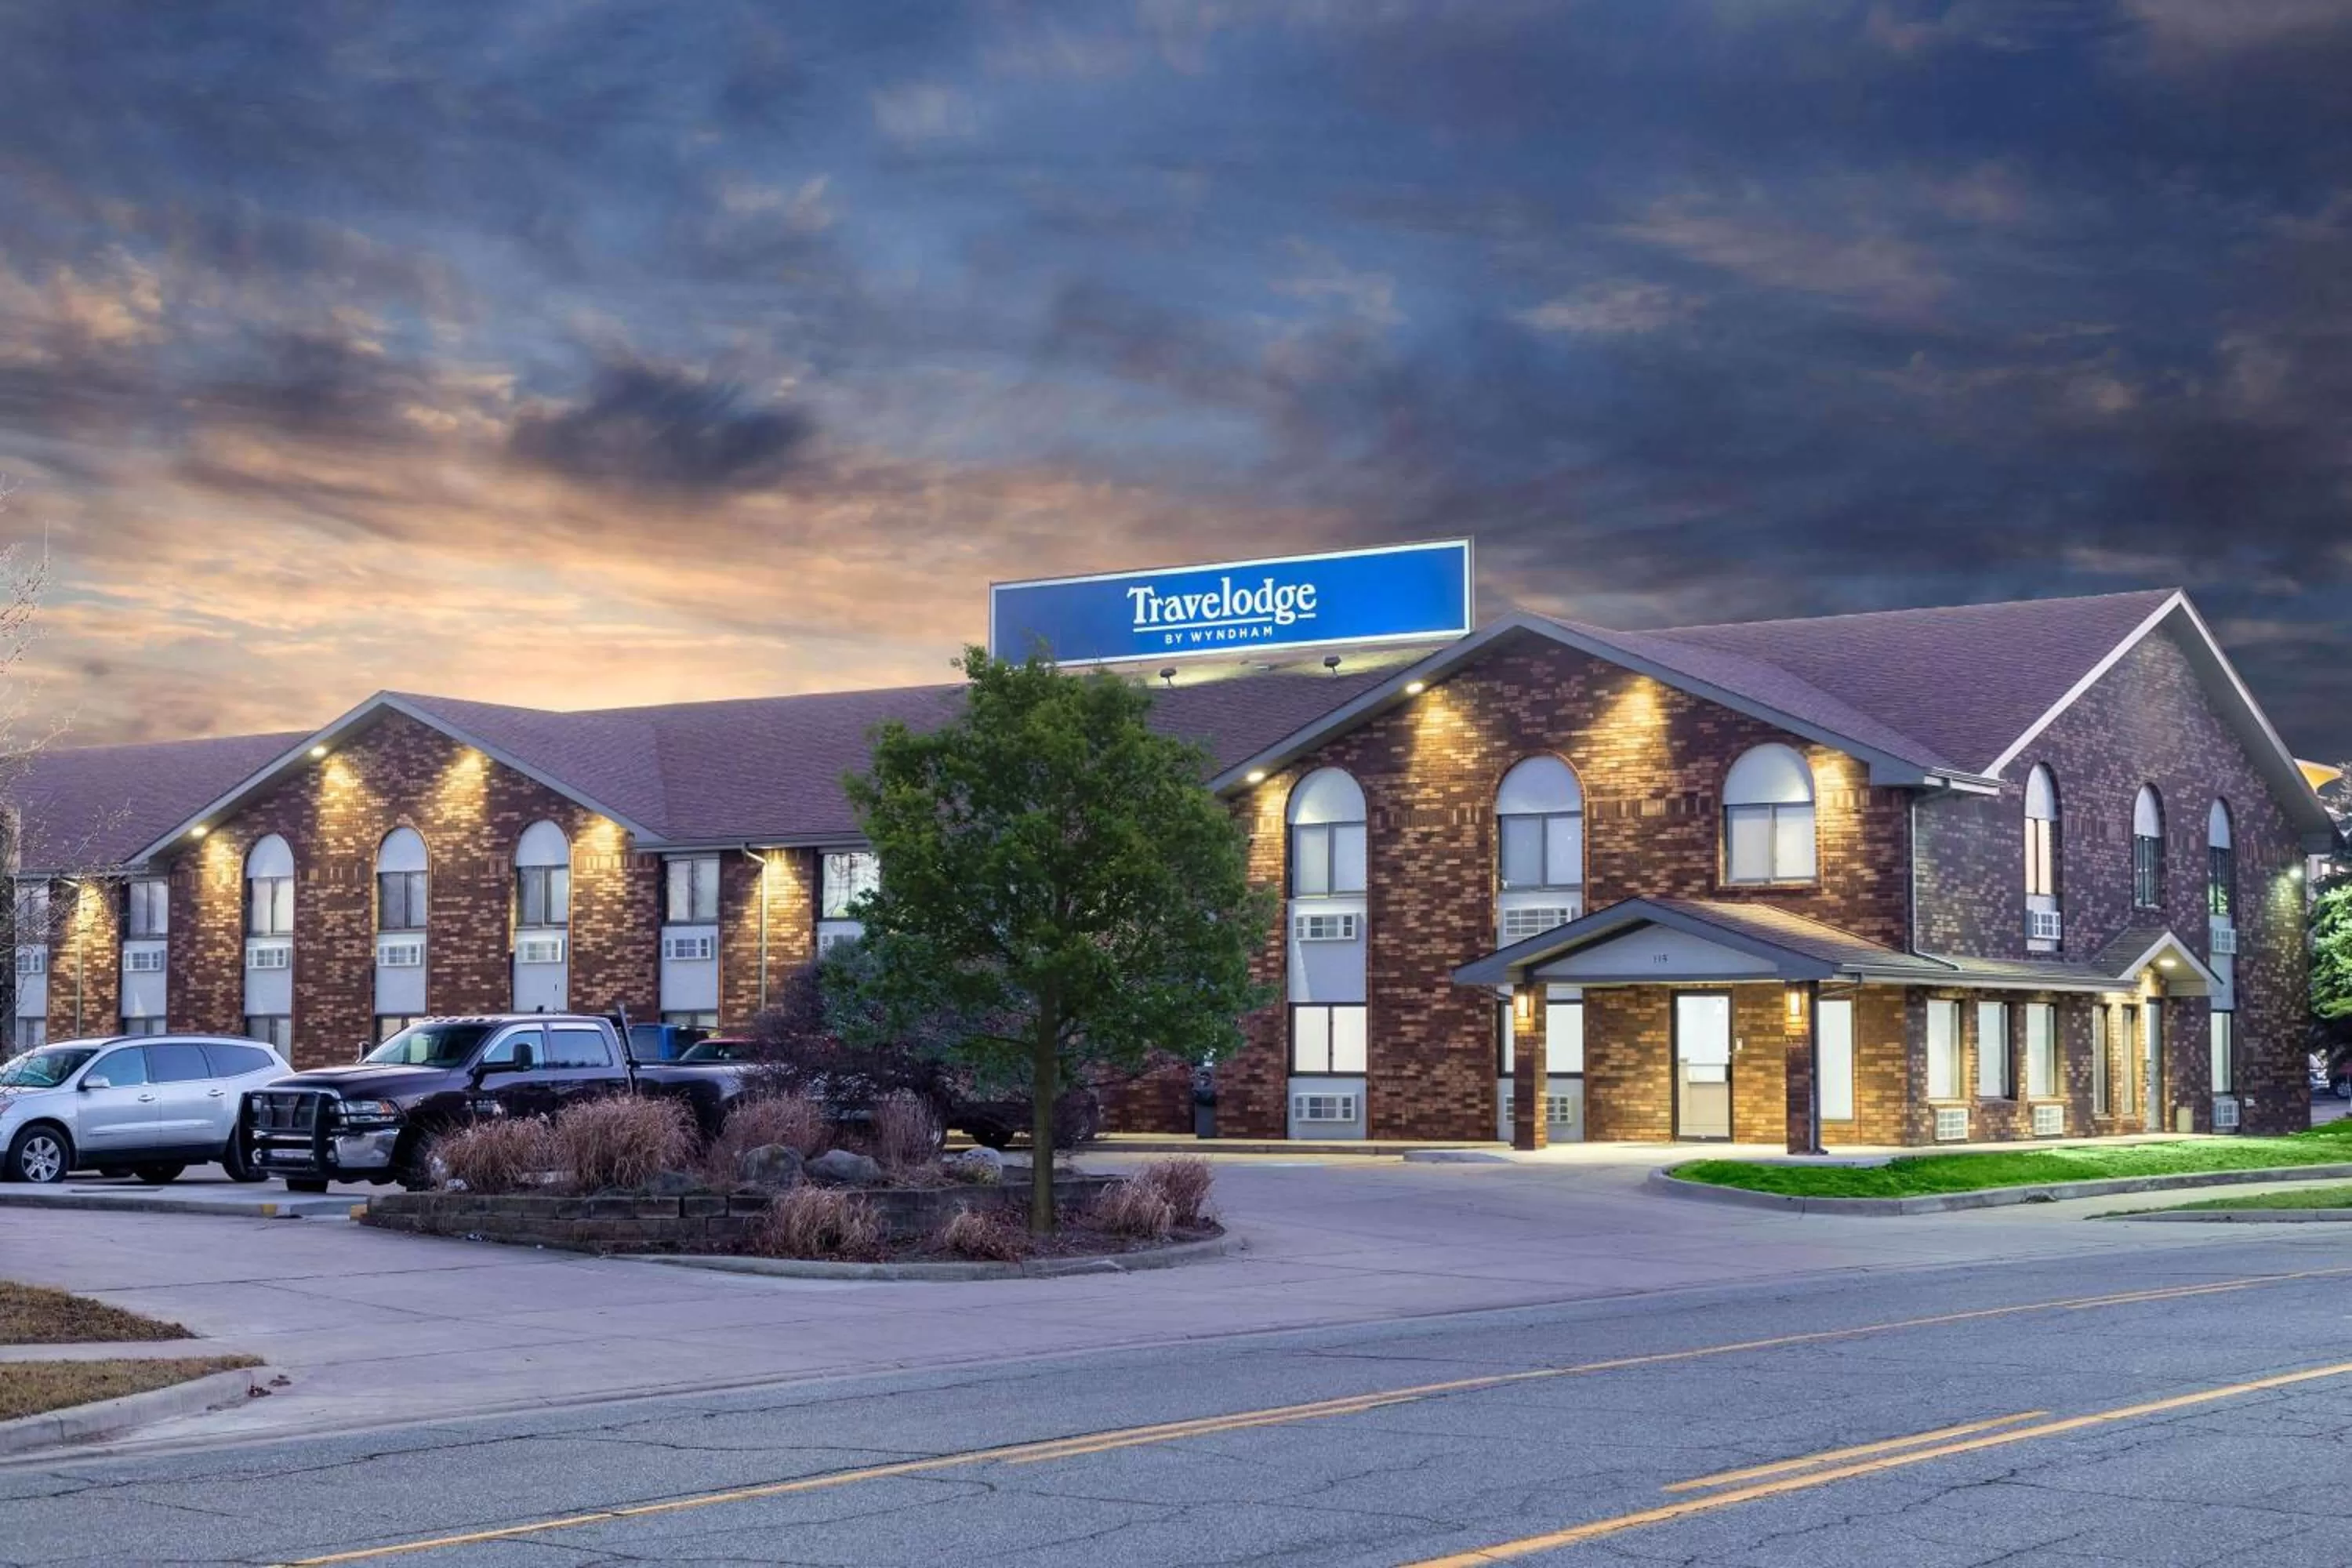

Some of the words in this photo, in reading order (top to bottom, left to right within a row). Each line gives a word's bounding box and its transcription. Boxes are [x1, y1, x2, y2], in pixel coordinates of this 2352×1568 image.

[1127, 577, 1317, 625] Travelodge
[1165, 633, 1182, 645] BY
[1191, 626, 1273, 643] WYNDHAM
